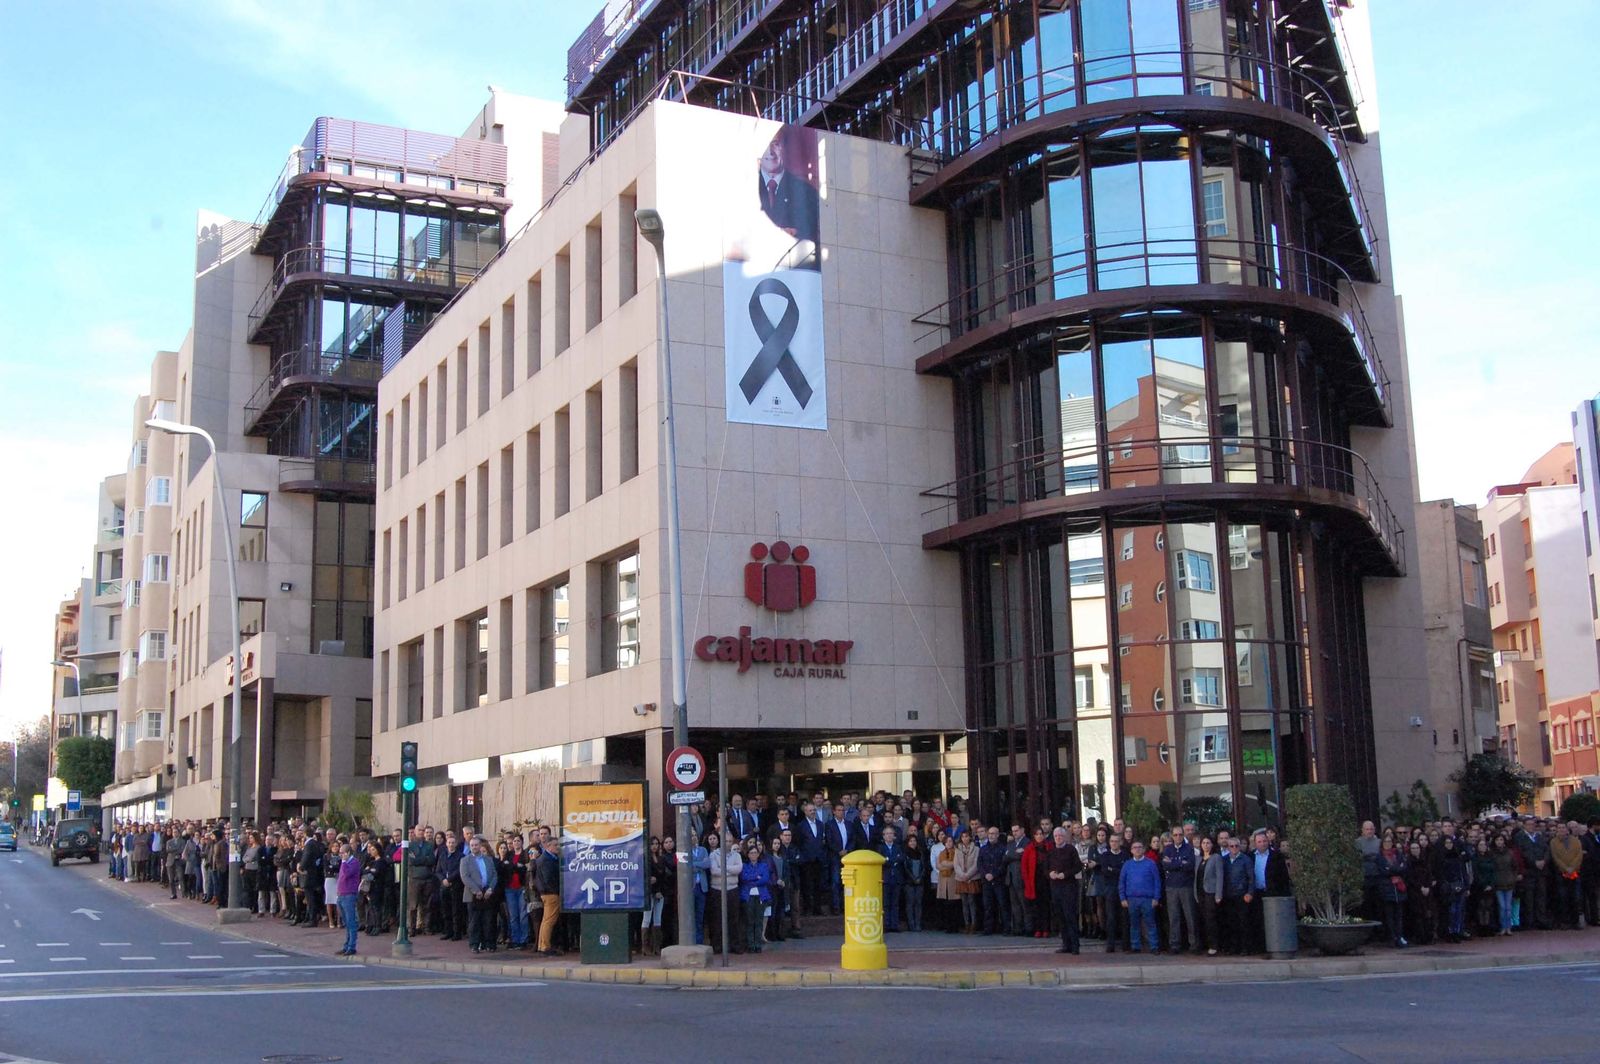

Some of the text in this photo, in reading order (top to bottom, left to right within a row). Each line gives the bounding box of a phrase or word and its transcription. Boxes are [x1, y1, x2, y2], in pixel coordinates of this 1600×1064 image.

[696, 626, 854, 673] cajamar
[774, 667, 847, 679] CAJA RURAL
[815, 742, 861, 757] ajamar
[579, 798, 629, 806] supermercados
[567, 810, 638, 824] consum
[601, 850, 628, 860] Ronda
[568, 862, 579, 872] C/
[620, 861, 638, 871] Oña
[609, 880, 626, 902] P
